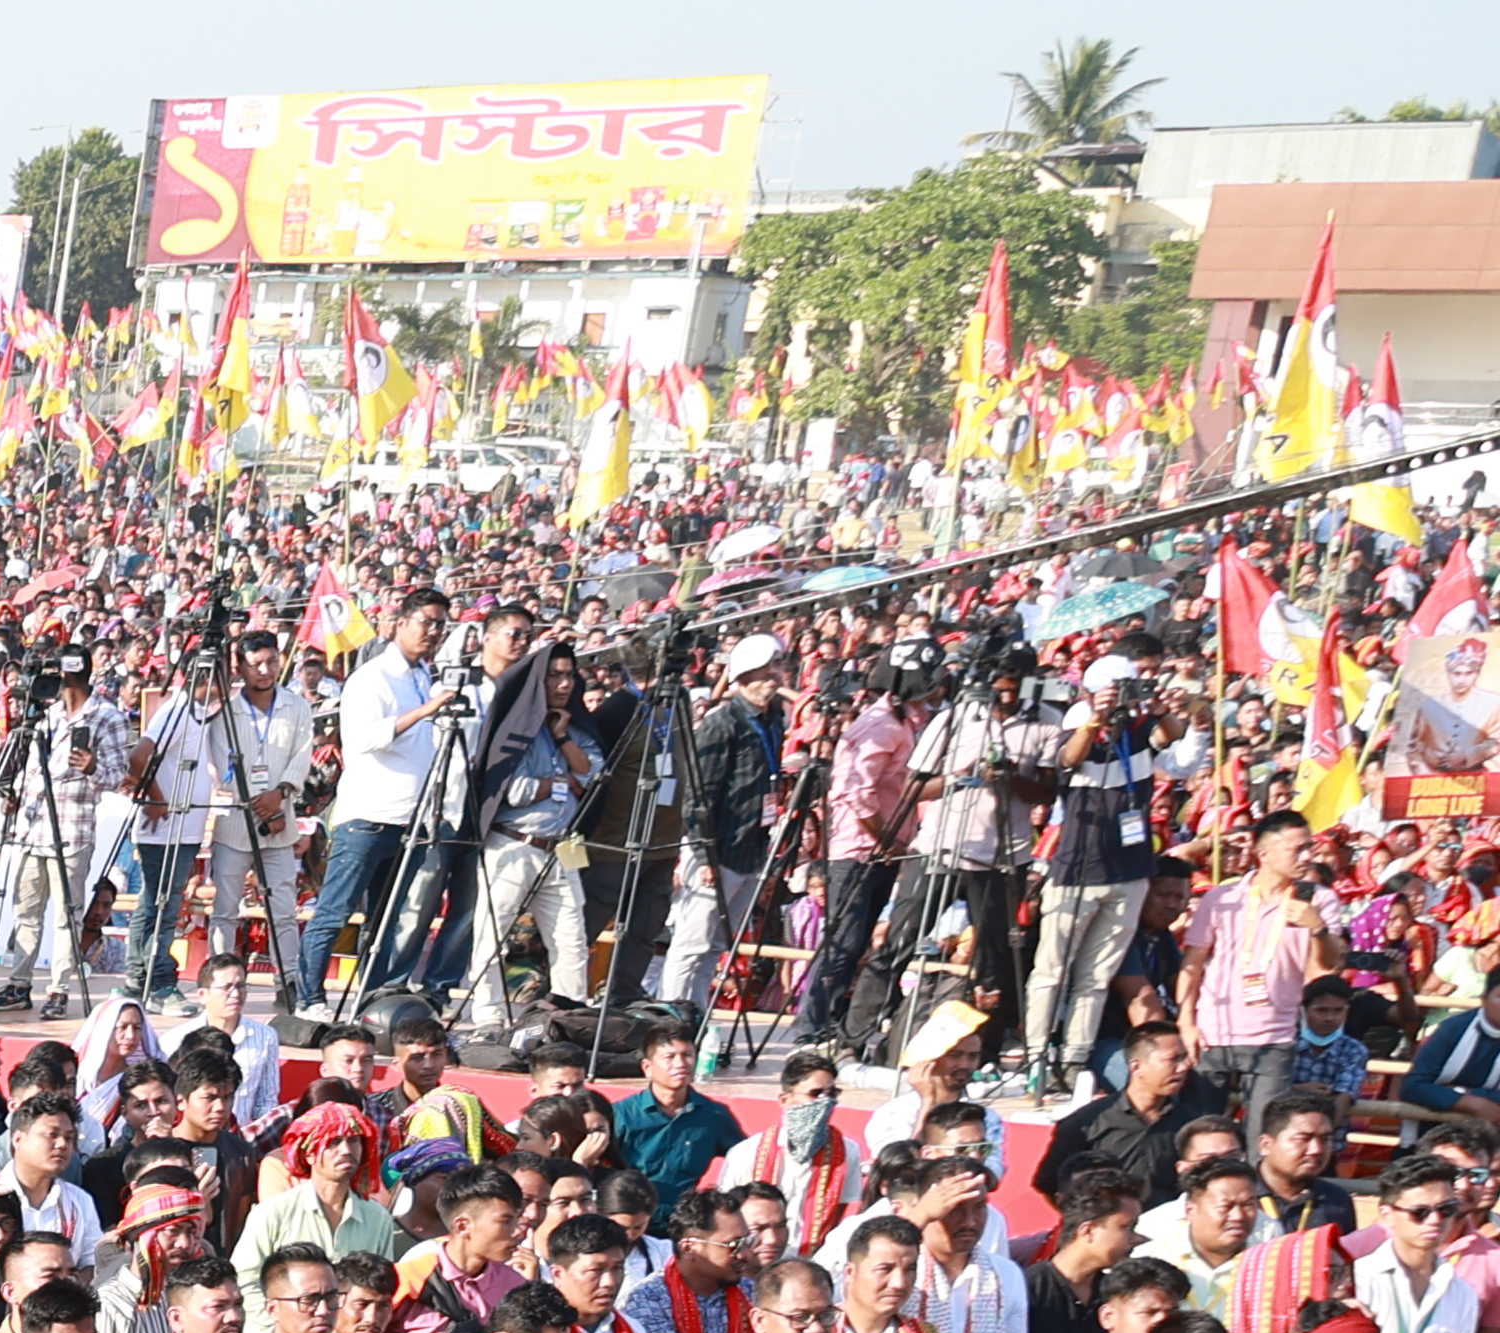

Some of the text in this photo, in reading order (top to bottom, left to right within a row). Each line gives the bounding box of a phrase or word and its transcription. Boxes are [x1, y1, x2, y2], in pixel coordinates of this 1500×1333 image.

[303, 95, 745, 166] সিস্টার
[1406, 794, 1485, 818] LONG LIVE
